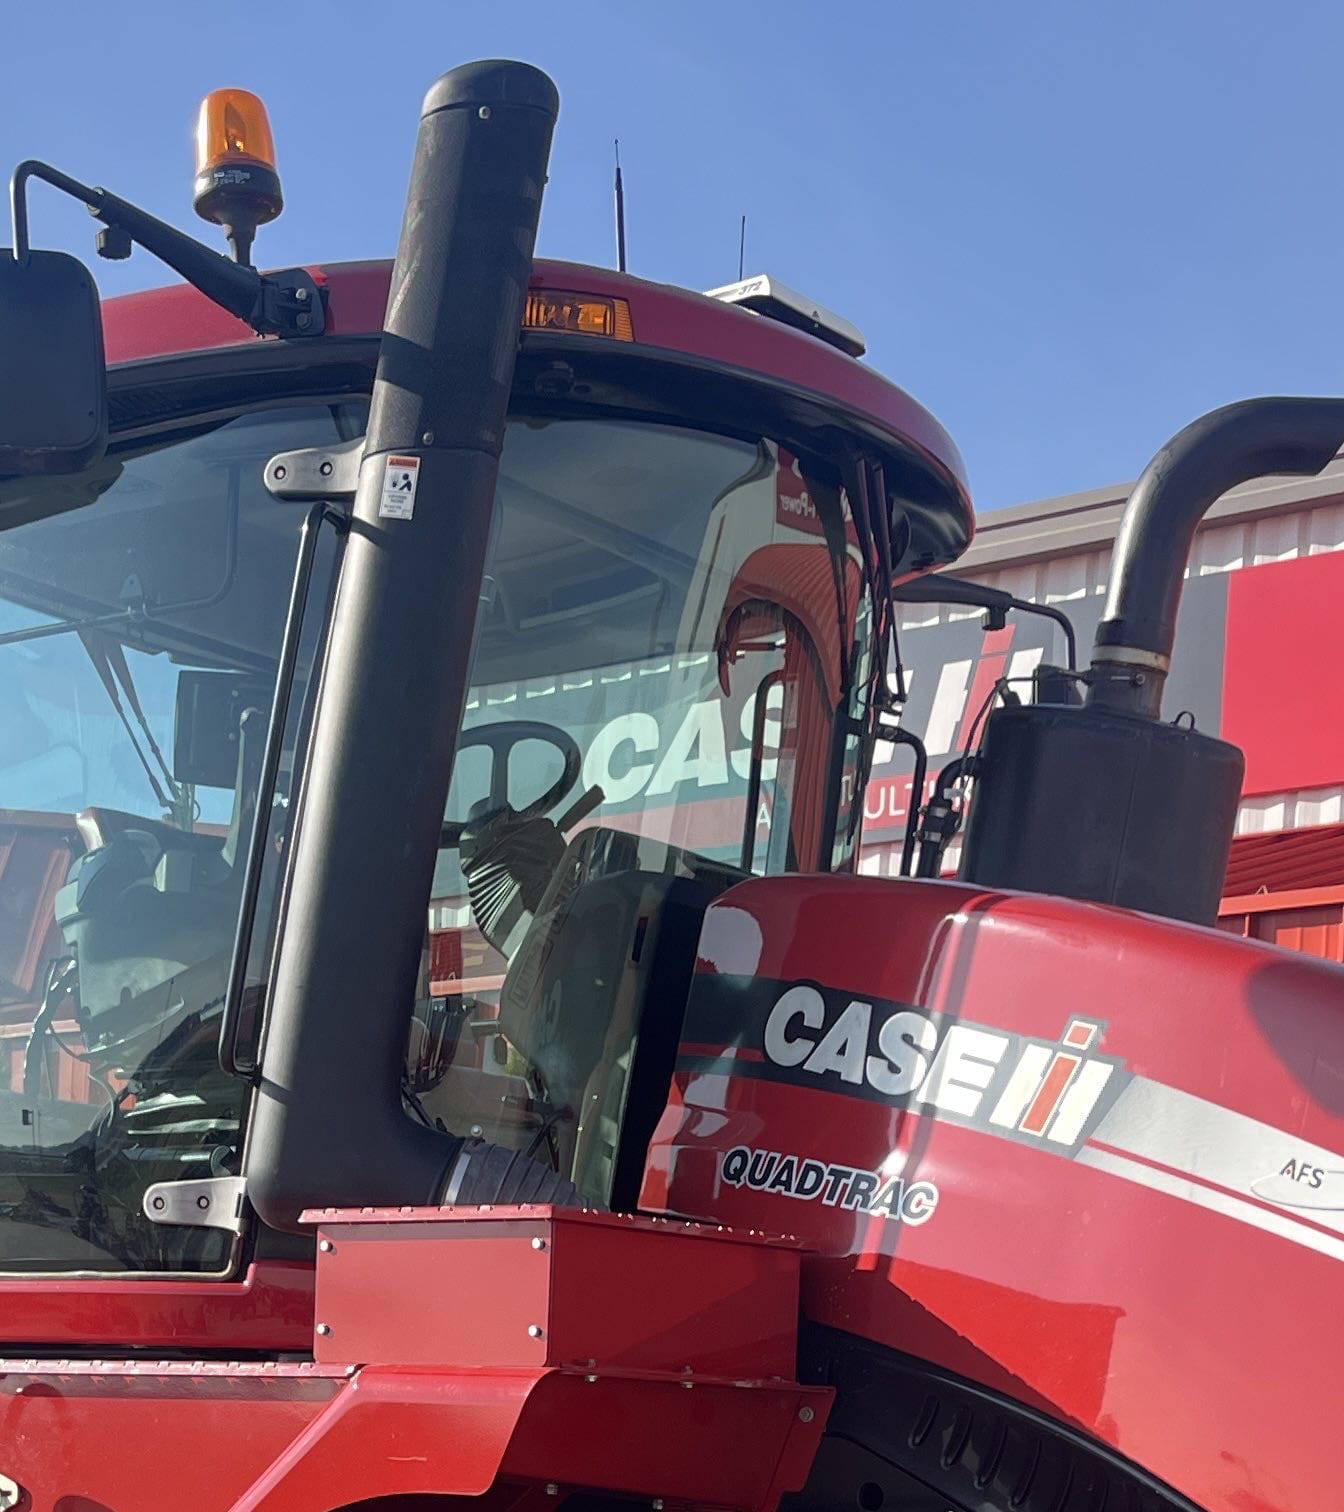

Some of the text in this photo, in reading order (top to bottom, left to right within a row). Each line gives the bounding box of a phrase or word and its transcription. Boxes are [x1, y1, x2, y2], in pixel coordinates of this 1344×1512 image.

[764, 985, 1009, 1117] CASE
[722, 1145, 939, 1227] QUADTRAC
[1279, 1158, 1325, 1189] AFS
